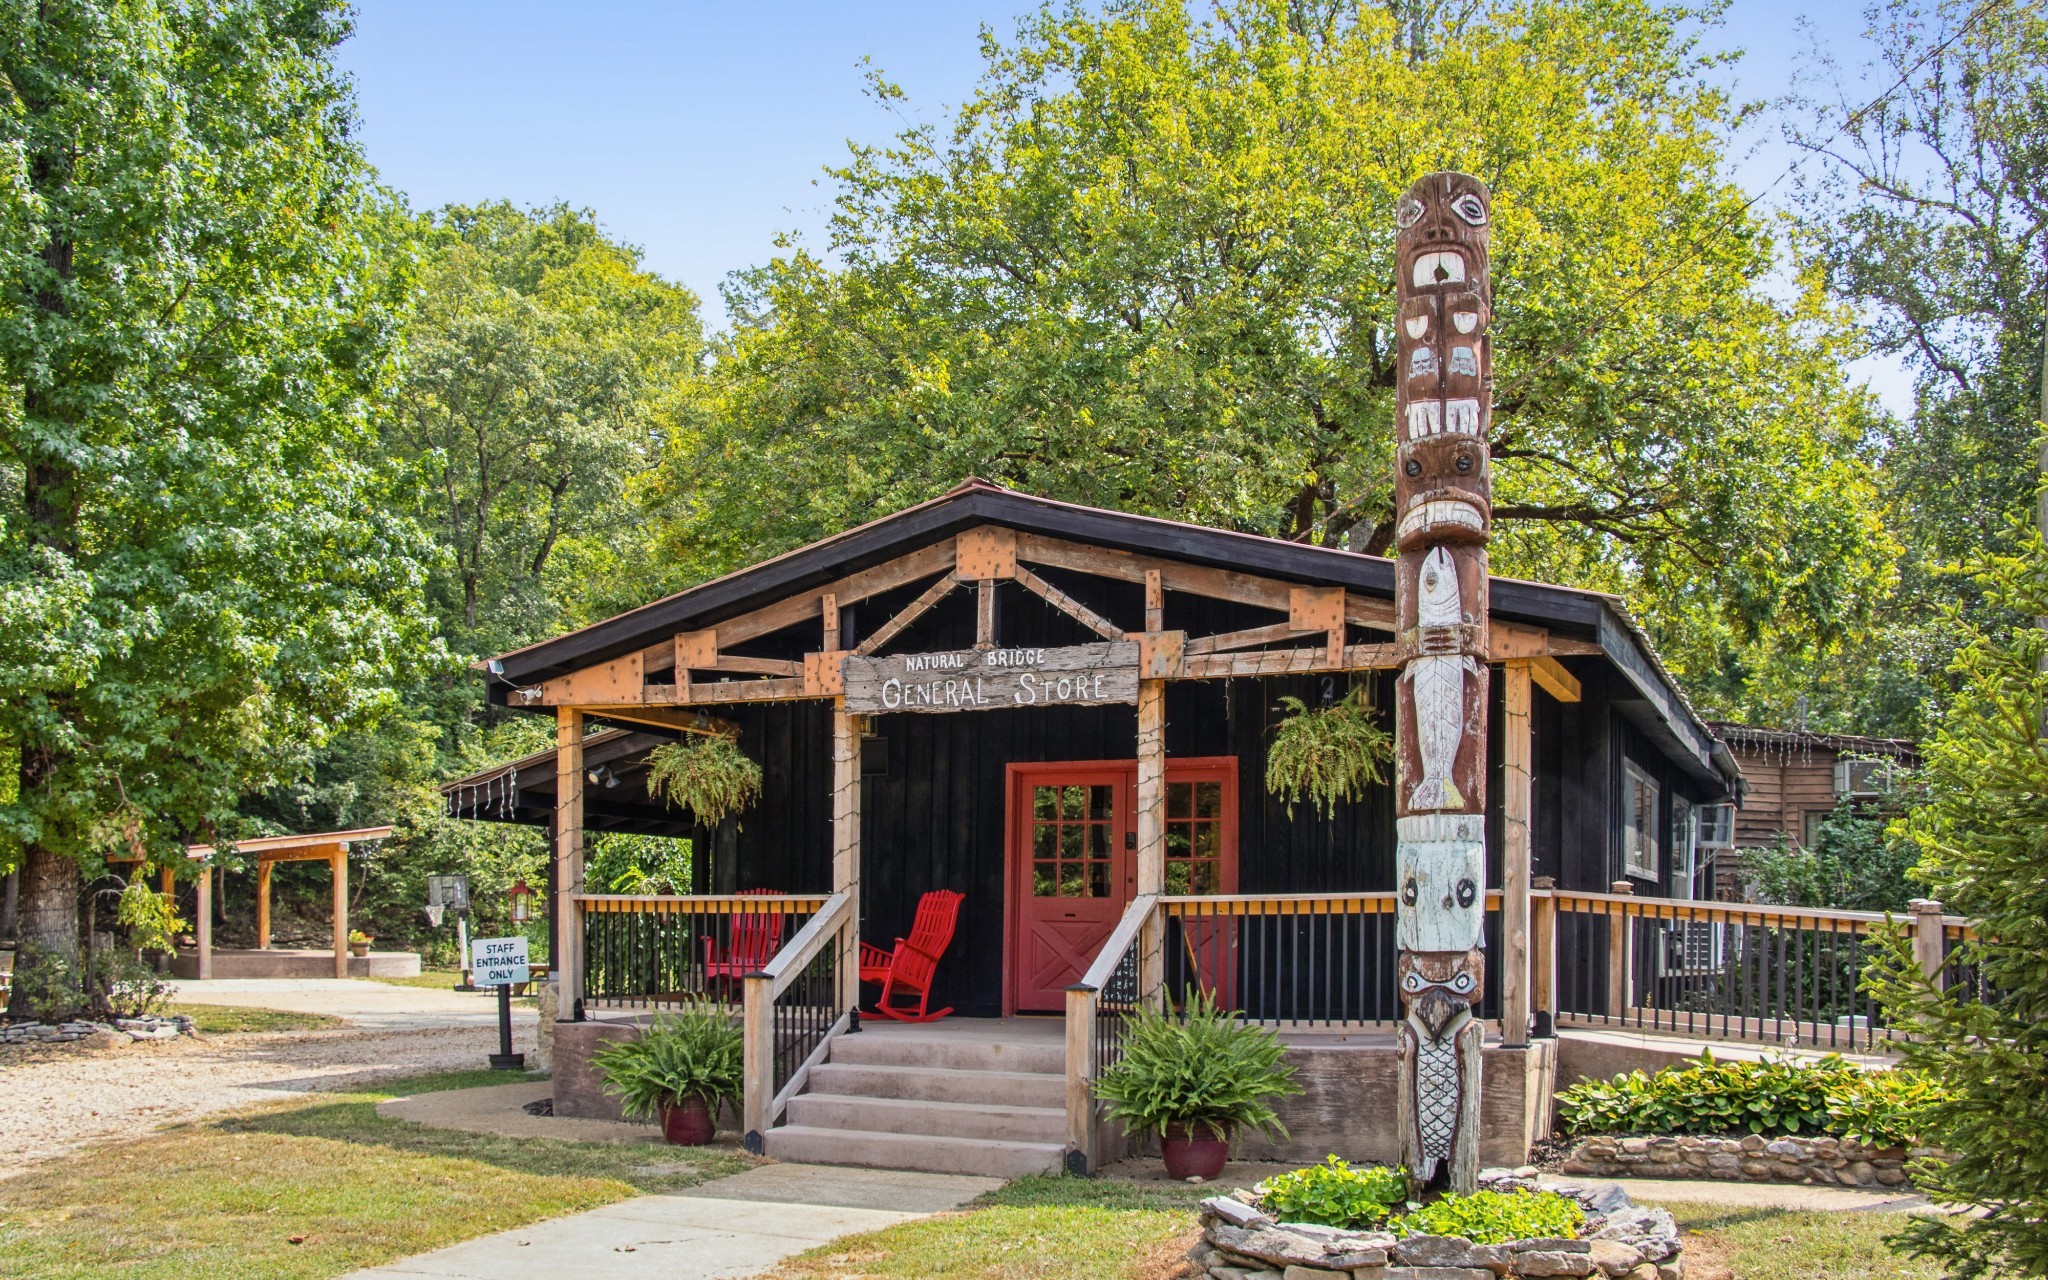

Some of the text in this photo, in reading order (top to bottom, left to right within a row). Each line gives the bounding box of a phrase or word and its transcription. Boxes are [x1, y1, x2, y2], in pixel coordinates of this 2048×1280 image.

[906, 649, 1045, 672] NATURAL BRIDGE
[882, 673, 1109, 708] GENERAL STORE
[486, 943, 514, 954] STAFF
[476, 955, 525, 968] ENTRANCE
[488, 969, 513, 980] ONLY
